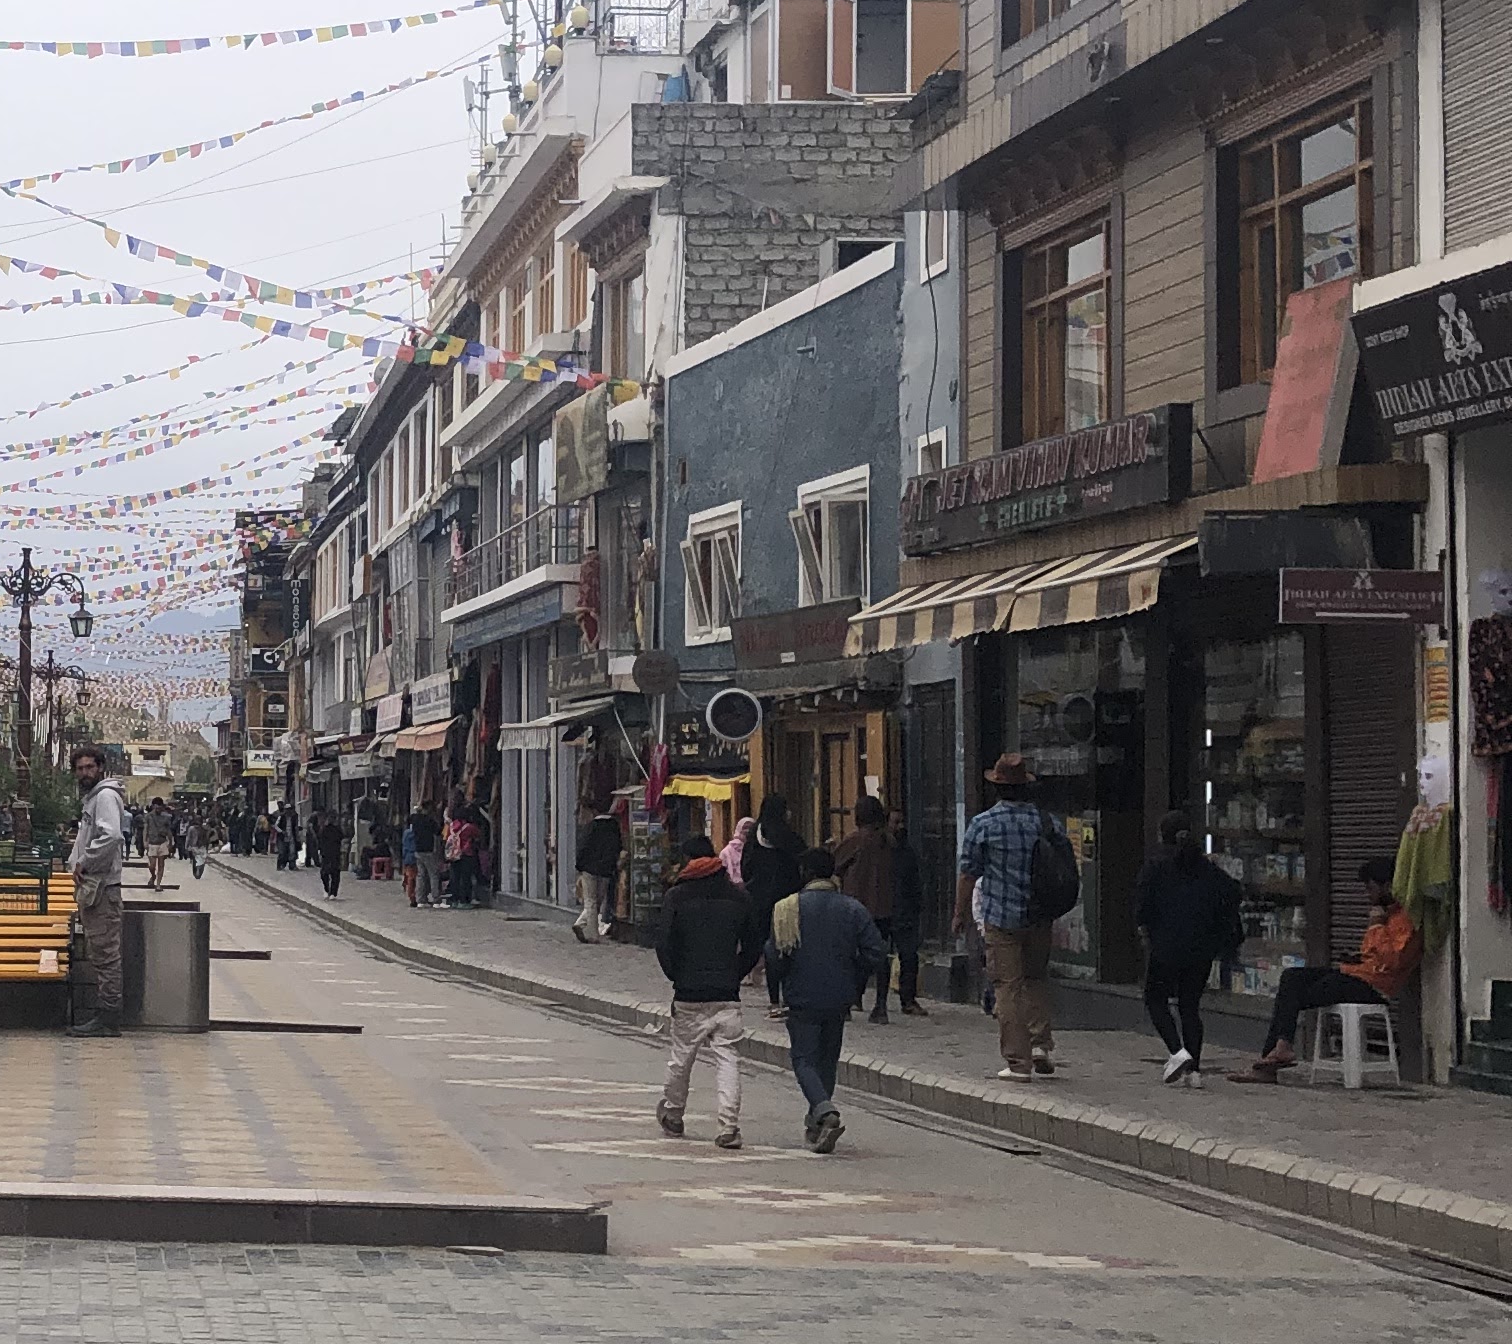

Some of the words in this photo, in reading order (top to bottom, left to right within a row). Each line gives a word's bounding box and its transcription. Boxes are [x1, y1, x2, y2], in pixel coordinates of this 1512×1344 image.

[1376, 378, 1437, 419] INDIAN
[1439, 367, 1482, 405] ARTS
[1073, 414, 1150, 479] KUMAR
[290, 579, 302, 637] monsoon
